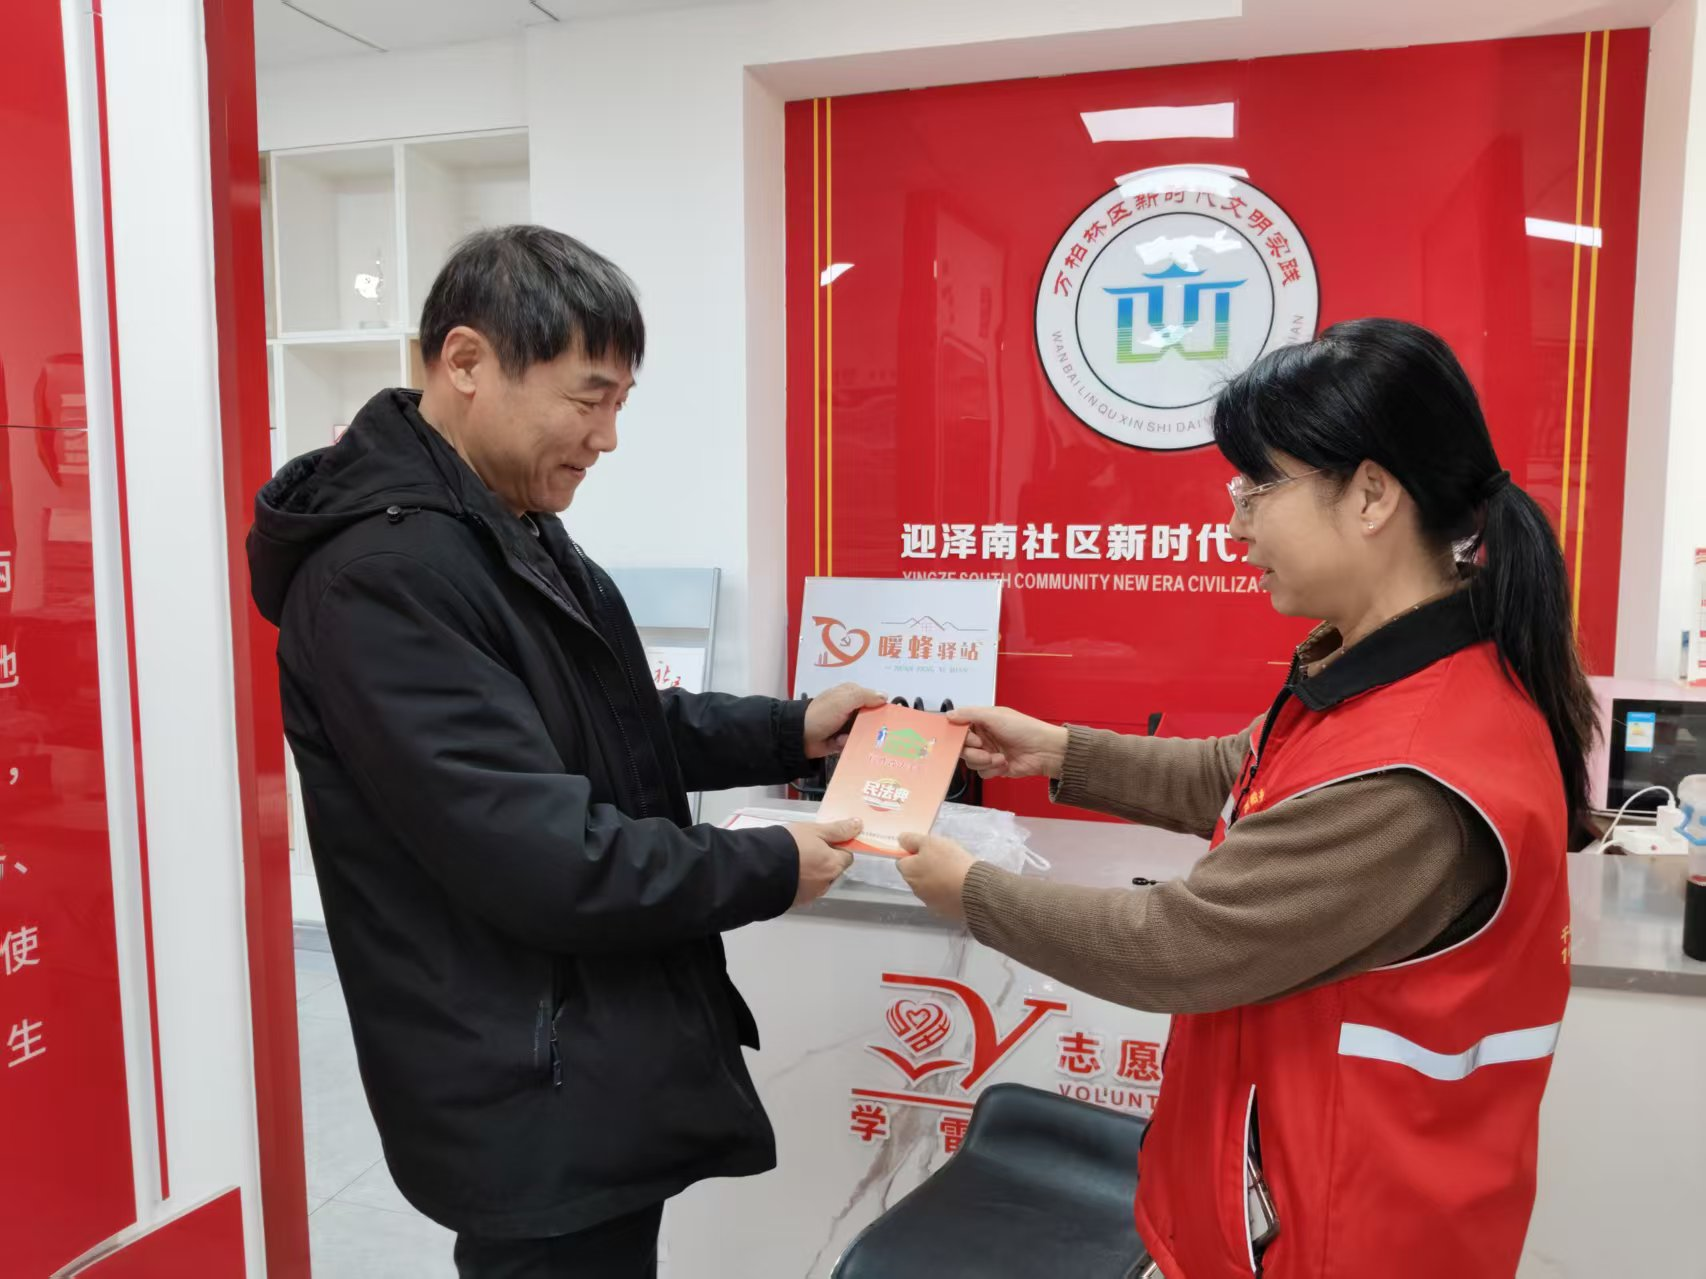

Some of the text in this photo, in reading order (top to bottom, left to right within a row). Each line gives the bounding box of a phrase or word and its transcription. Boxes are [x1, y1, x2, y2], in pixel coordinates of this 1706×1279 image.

[901, 522, 1249, 562] 迎泽南社区新时代
[1014, 572, 1110, 591] COMMUNITY
[1113, 574, 1149, 591] NEW
[1152, 575, 1185, 592] ERA
[1187, 575, 1267, 594] CIVILIZA
[878, 634, 979, 661] 暖蜂驿站
[0, 925, 41, 976] 使
[6, 1018, 47, 1069] 生
[1058, 1032, 1162, 1082] 志愿
